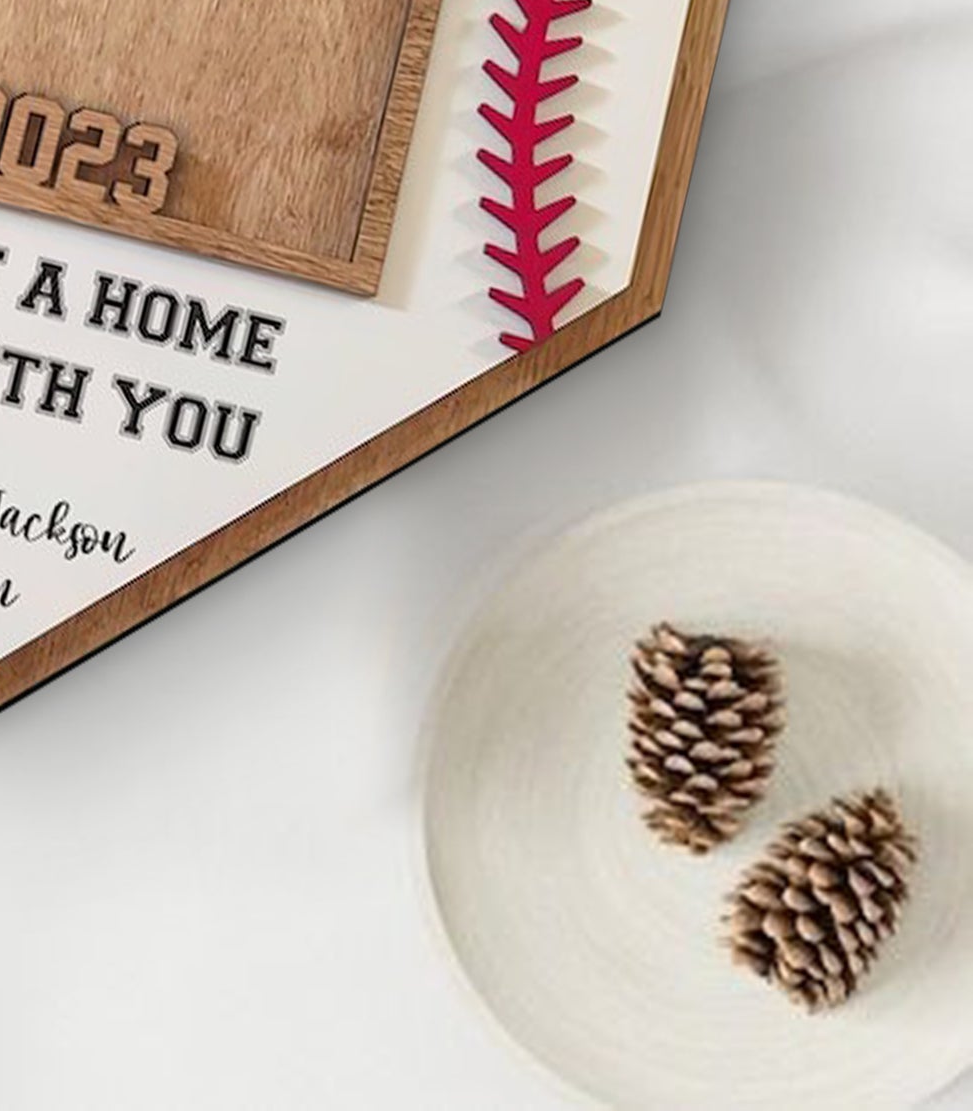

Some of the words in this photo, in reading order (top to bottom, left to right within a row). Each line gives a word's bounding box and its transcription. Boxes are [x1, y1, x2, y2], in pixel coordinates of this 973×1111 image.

[18, 257, 69, 319] A
[86, 270, 285, 374] HOME
[111, 373, 262, 465] YOU
